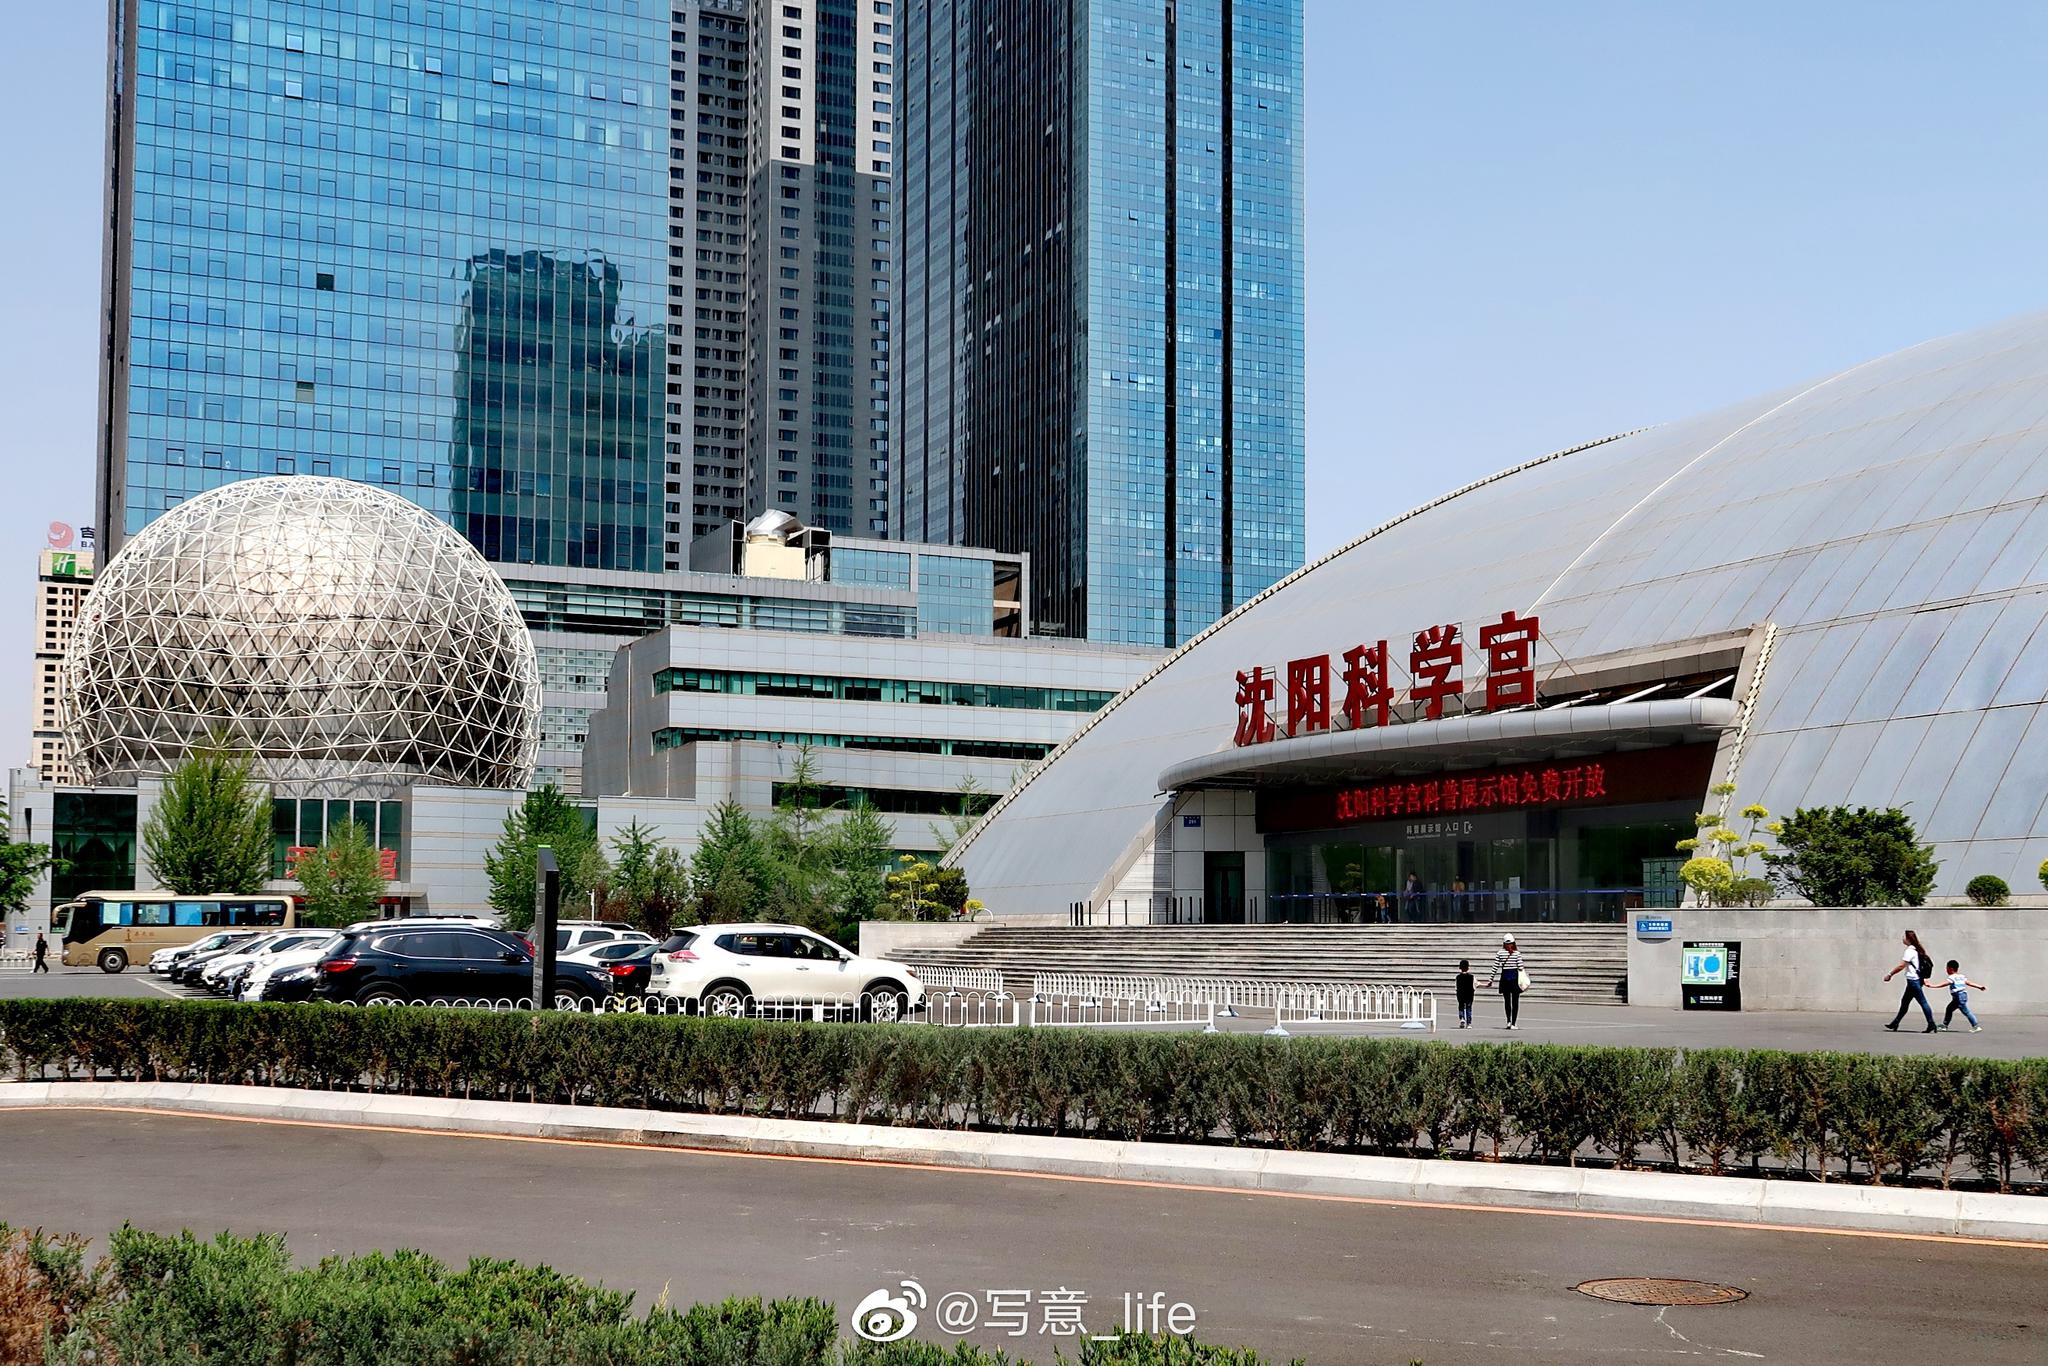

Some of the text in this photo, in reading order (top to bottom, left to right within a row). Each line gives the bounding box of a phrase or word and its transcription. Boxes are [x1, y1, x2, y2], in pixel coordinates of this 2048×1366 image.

[1234, 610, 1539, 747] 沈阳科学宫
[1337, 763, 1607, 819] 沈阳科学宫科普展示馆免费开放
[1445, 822, 1459, 832] 入口
